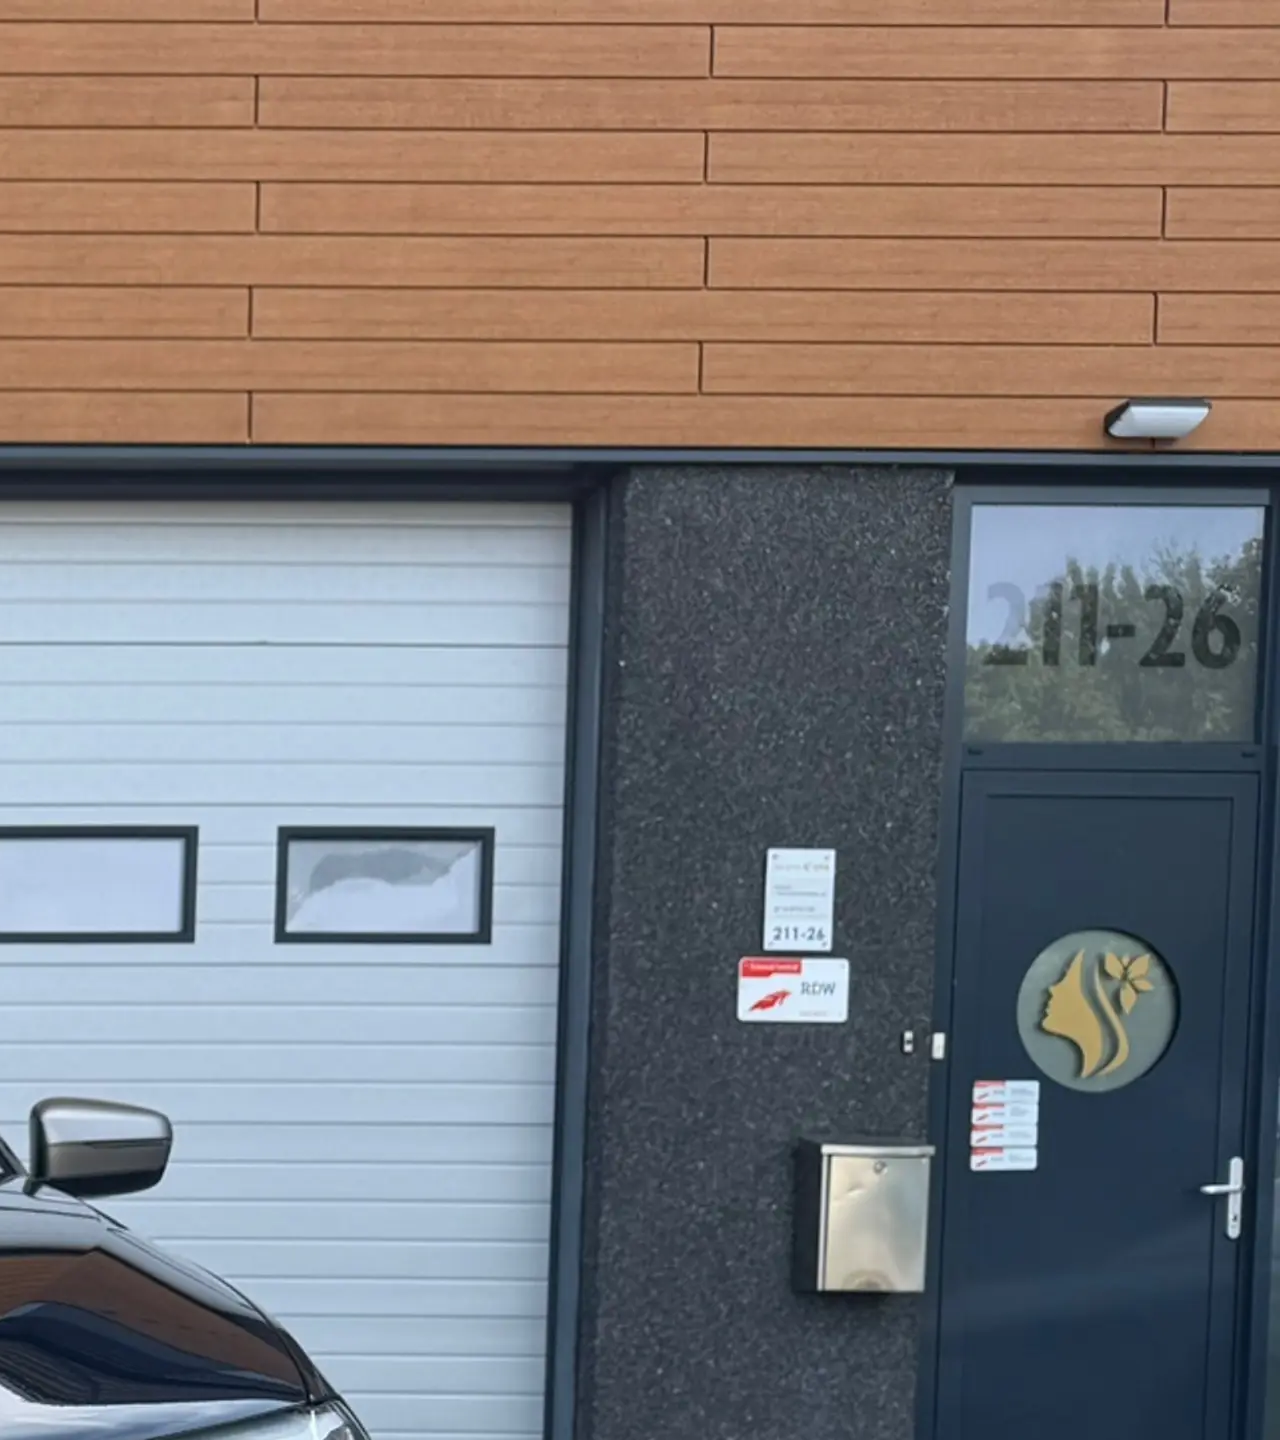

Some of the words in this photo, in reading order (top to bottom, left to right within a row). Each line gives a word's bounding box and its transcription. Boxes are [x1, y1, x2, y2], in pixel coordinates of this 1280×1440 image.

[983, 581, 1240, 669] 211-26
[772, 926, 826, 942] 211-26
[800, 981, 837, 996] RDW
